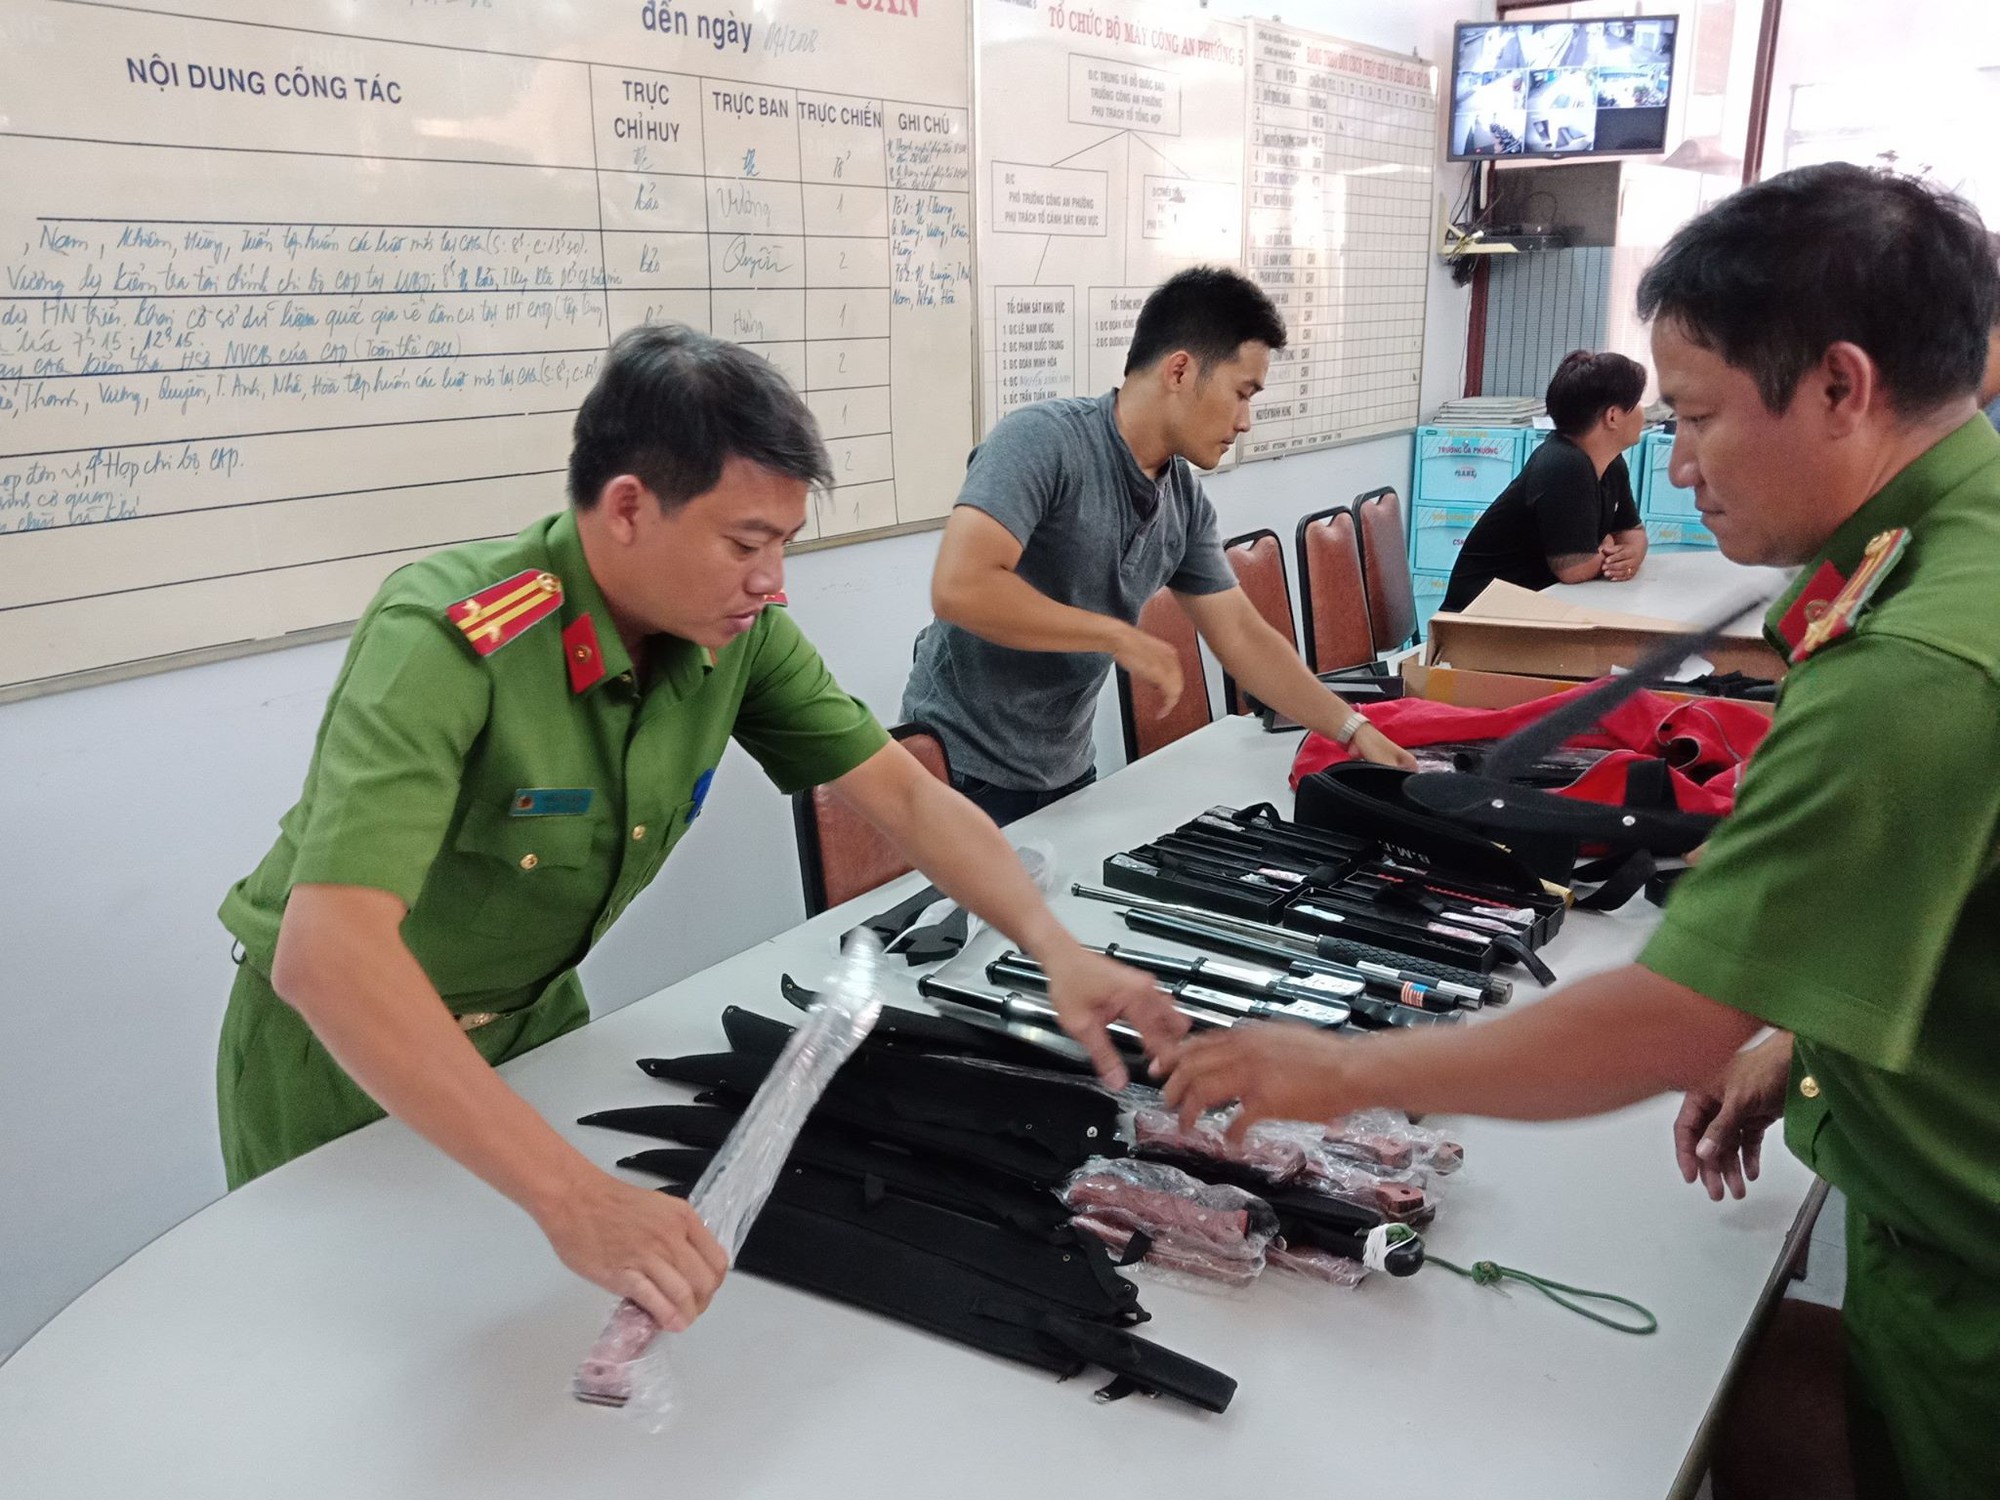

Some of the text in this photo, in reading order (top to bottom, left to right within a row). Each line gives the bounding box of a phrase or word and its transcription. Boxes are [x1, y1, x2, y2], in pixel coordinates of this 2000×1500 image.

[697, 11, 752, 53] ngày
[1069, 8, 1102, 37] CHỨC
[1106, 16, 1121, 45] BỘ
[1124, 20, 1148, 46] MÁY
[1151, 28, 1179, 53] CÔNG
[1181, 37, 1196, 56] AN
[1198, 39, 1235, 65] PHƯỜNG
[1238, 49, 1244, 67] 5
[126, 53, 402, 104] NỘI DUNG CÔNG TÁC
[622, 81, 669, 109] TRỰC
[713, 92, 789, 121] TRỰC BAN
[798, 102, 882, 128] TRỰC CHIẾN
[614, 113, 679, 143] CHỈ HUY
[898, 112, 949, 134] GHI CHÚ
[838, 193, 843, 213] 1
[840, 252, 848, 269] 2
[839, 304, 847, 327] 1
[1017, 298, 1030, 313] CẢNH
[1032, 300, 1042, 314] SÁT
[1043, 302, 1053, 313] KHU
[1055, 301, 1065, 315] VỰC
[1018, 322, 1025, 334] LÊ
[1026, 324, 1037, 334] NAM
[839, 352, 846, 373] 2
[1033, 358, 1046, 368] MINH
[842, 404, 847, 424] 1
[845, 451, 854, 471] 2
[854, 502, 860, 523] 1
